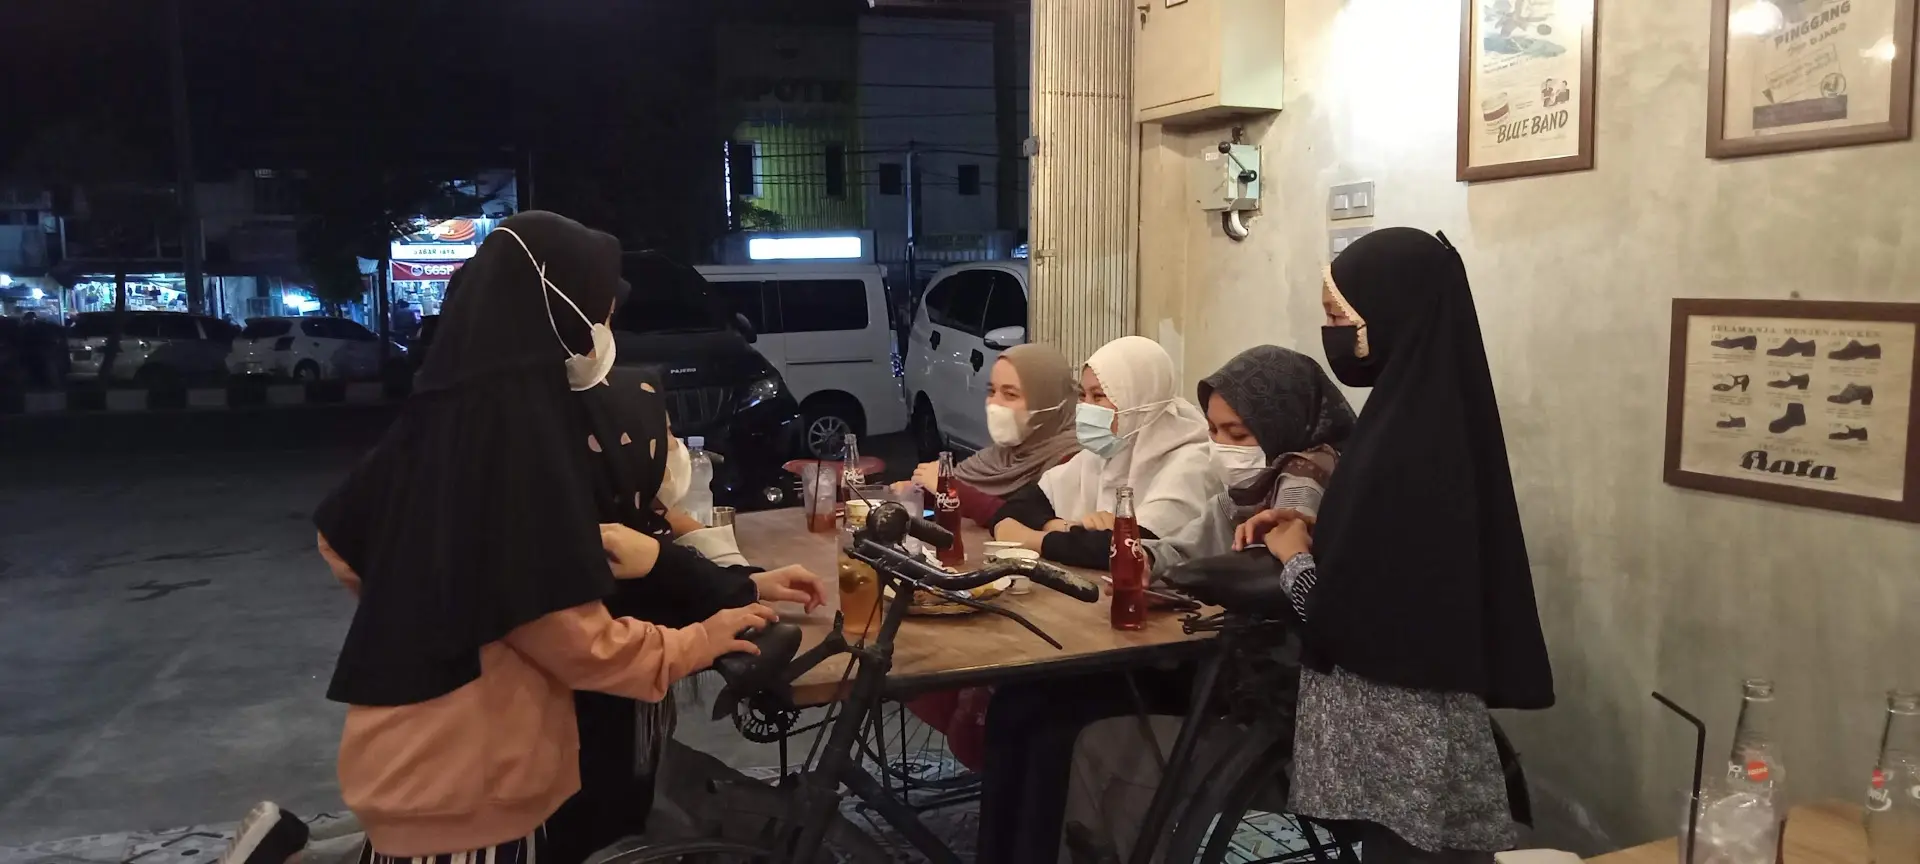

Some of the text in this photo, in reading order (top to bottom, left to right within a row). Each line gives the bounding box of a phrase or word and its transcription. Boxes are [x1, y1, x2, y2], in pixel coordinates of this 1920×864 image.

[1774, 0, 1851, 50] PINGGANG
[1497, 118, 1529, 143] BLUE
[1531, 110, 1568, 135] BAND
